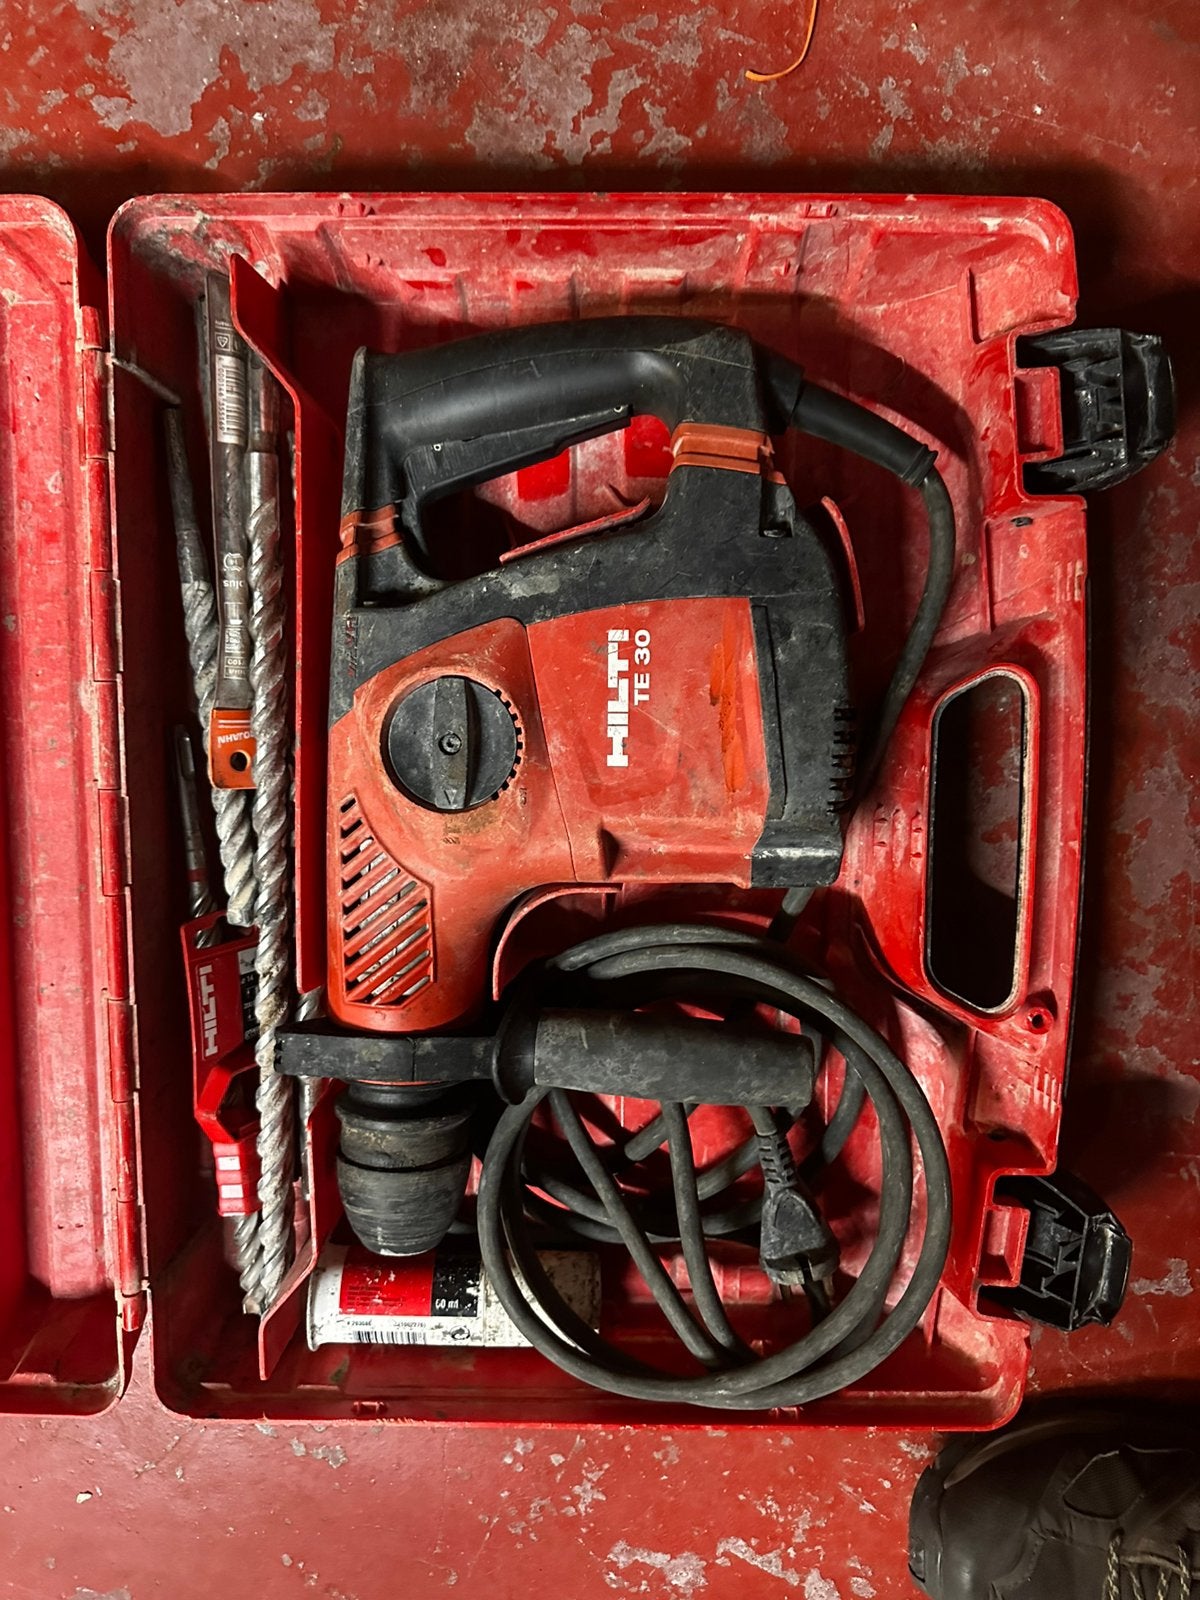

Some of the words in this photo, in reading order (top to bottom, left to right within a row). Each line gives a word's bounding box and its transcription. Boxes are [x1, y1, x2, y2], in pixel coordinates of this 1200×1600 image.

[634, 629, 651, 666] 30
[607, 629, 629, 767] HILTI
[634, 672, 650, 706] TE
[200, 964, 218, 1057] HILTI
